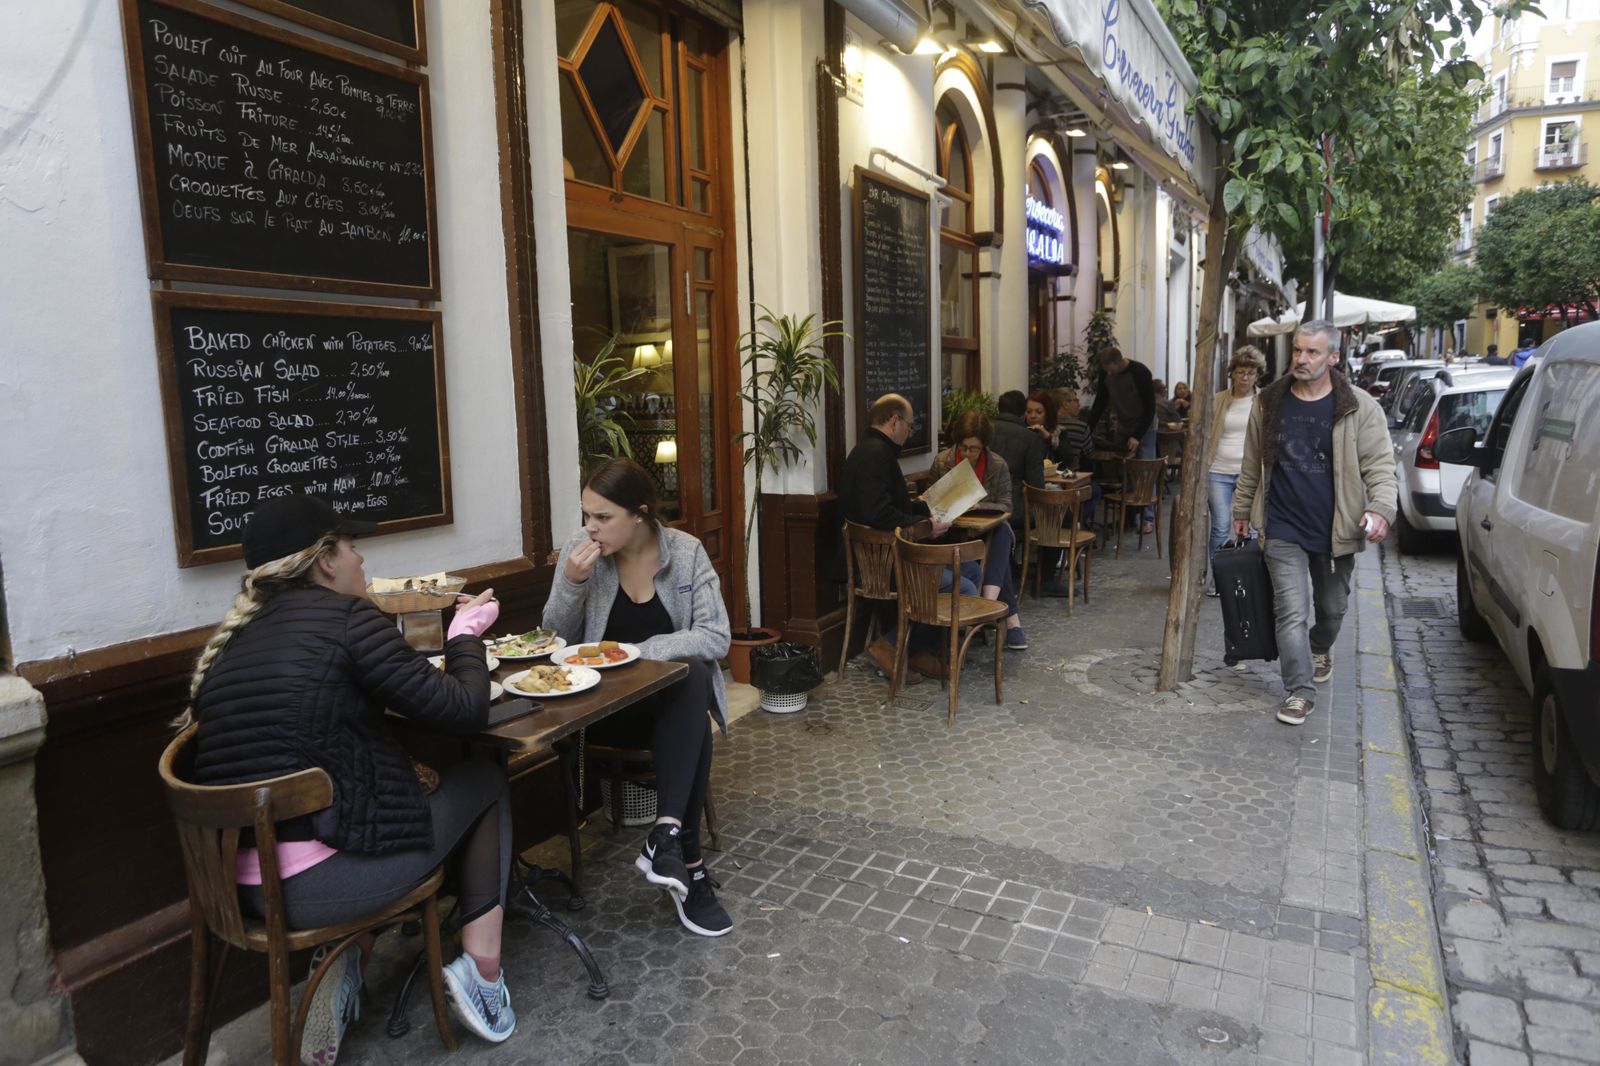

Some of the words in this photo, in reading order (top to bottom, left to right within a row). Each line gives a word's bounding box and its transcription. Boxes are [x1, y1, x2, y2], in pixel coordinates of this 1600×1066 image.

[149, 19, 213, 55] POULET
[218, 45, 248, 64] CUIT
[255, 58, 274, 76] AU
[278, 58, 304, 83] FOUR
[309, 70, 334, 90] AVEC
[335, 74, 373, 103] POMMES
[386, 93, 416, 113] TERRE
[154, 54, 219, 86] SALADE
[231, 72, 284, 103] RUSSE
[154, 82, 224, 115] POISSON
[235, 101, 300, 130] FRITURE
[156, 113, 227, 142] FRUITS
[238, 131, 261, 149] DE
[271, 134, 298, 155] MER
[167, 142, 229, 170] MORUE
[267, 158, 327, 189] GIRALDA
[169, 173, 266, 202] CROQUETTES
[275, 188, 299, 207] AUX
[172, 199, 222, 222] OEUFS
[230, 210, 257, 225] SUR
[284, 211, 313, 233] PLAT
[318, 218, 335, 237] AU
[183, 325, 252, 357] BAKED
[262, 330, 318, 352] CHICKEN
[322, 335, 345, 352] WITH
[346, 330, 398, 354] POTATOES
[185, 357, 265, 382] RUSSIAN
[273, 358, 321, 382] SALAD
[191, 384, 245, 408] FRIED
[252, 384, 291, 405] FISH
[193, 413, 262, 436] SEAFOOD
[267, 411, 315, 431] SALAD
[196, 438, 256, 461] CODFISH
[265, 434, 319, 455] GIRALDA
[325, 430, 361, 449] STYLE
[199, 463, 259, 484] BOLETUS
[266, 455, 338, 475] CROQUETTES
[199, 485, 252, 510] FRIED
[257, 483, 294, 501] EGGS
[303, 479, 328, 496] WITH
[333, 477, 357, 495] HAM
[332, 499, 351, 514] HAM
[365, 493, 389, 508] EGGS
